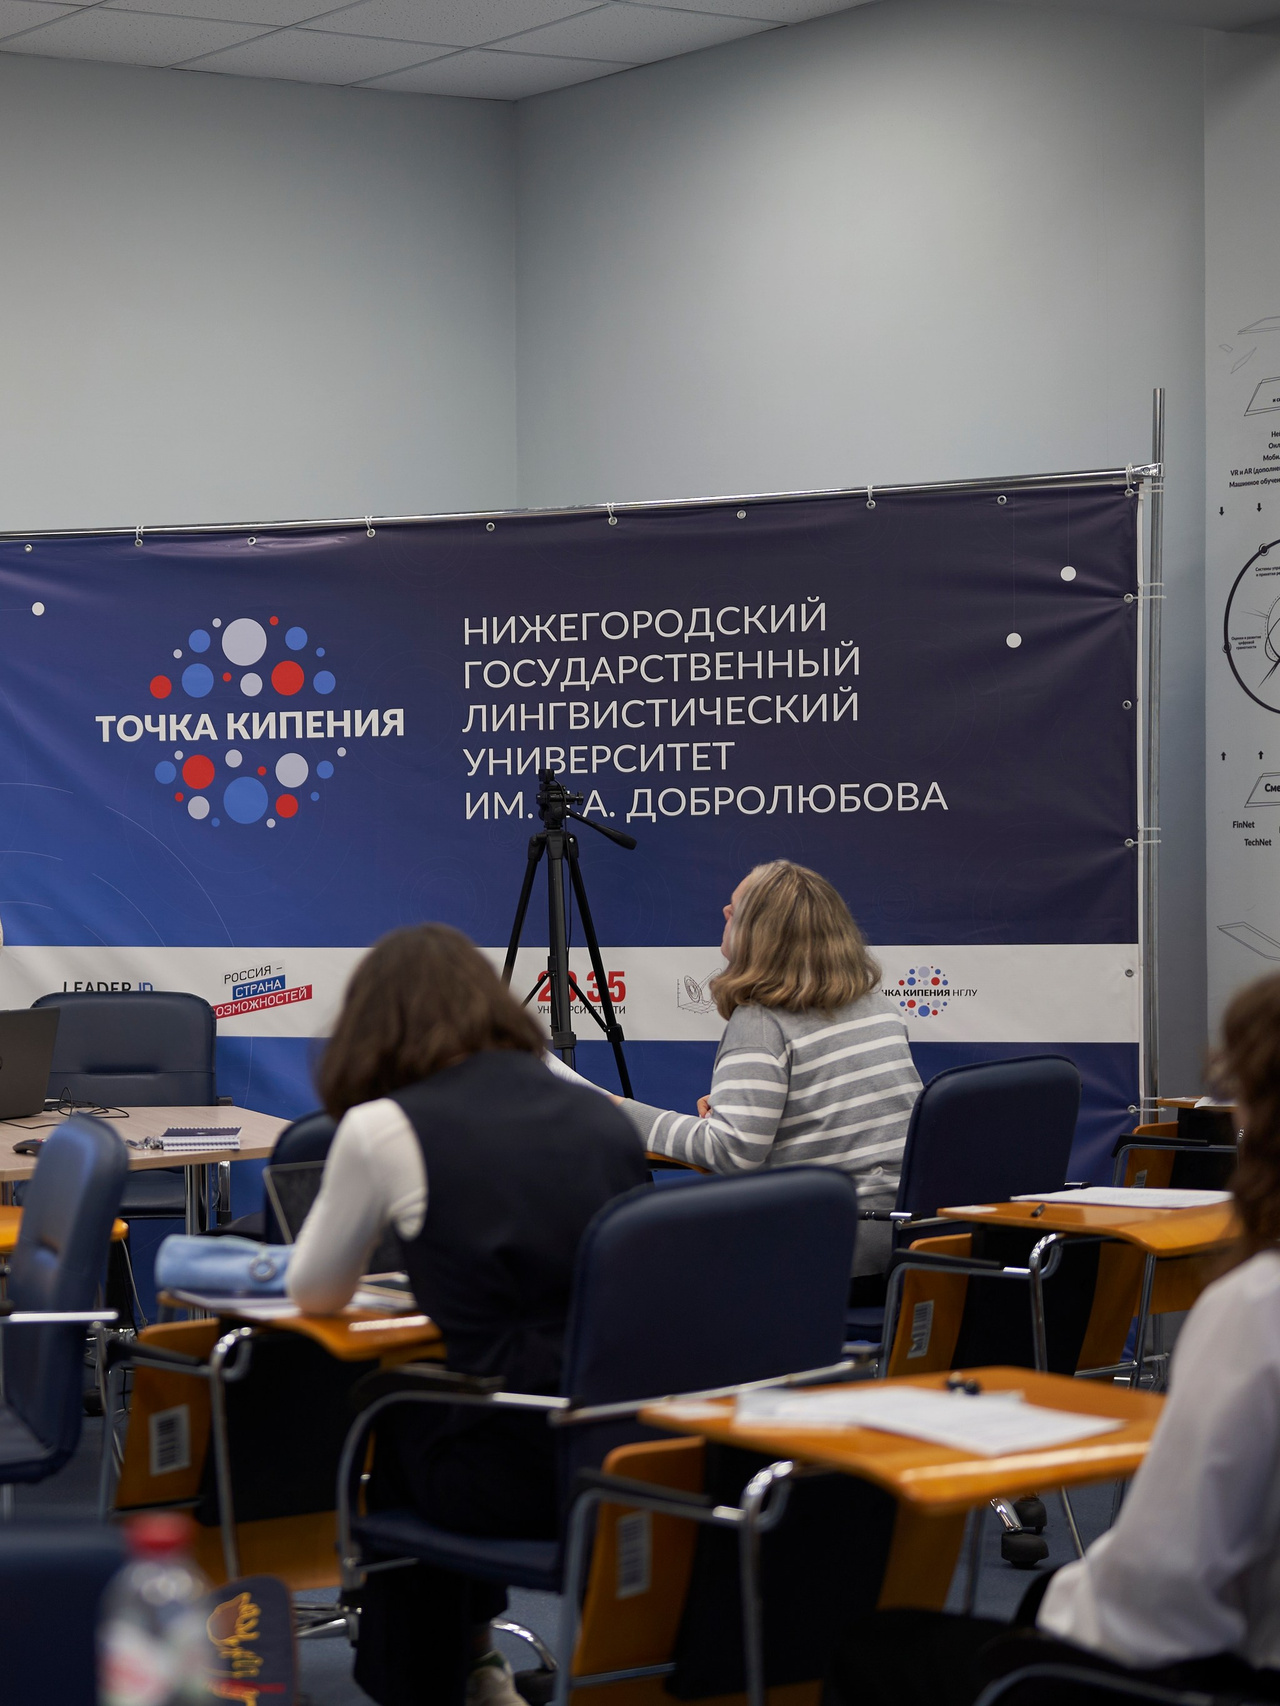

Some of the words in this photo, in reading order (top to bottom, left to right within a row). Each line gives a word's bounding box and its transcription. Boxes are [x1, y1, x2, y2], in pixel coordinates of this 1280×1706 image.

[1244, 467, 1253, 475] AR
[463, 596, 827, 645] НИЖЕГОРОДСКИЙ
[463, 640, 861, 692] ГОСУДАРСТВЕННЫЙ
[462, 685, 859, 734] ЛИНГВИСТИЧЕСКИЙ
[95, 713, 219, 743] ТОЧКА
[226, 708, 405, 741] КИПЕНИЯ
[462, 741, 736, 777] УНИВЕРСИТЕТ
[464, 791, 534, 820] ИМ.
[625, 781, 949, 824] ДОБРОЛЮБОВА
[1232, 820, 1256, 829] FinNet
[1244, 838, 1272, 847] TechNet
[224, 965, 272, 985] РОССИЯ
[235, 978, 282, 998] СТРАНА
[537, 970, 626, 1003] 235
[214, 986, 307, 1017] ОЗМОЖНОСТЕЙ
[882, 989, 901, 997] ЧКА
[903, 989, 950, 997] КИПЕНИЯ
[952, 989, 978, 997] НГЛУ
[537, 1005, 603, 1015] УНРСИЕТ
